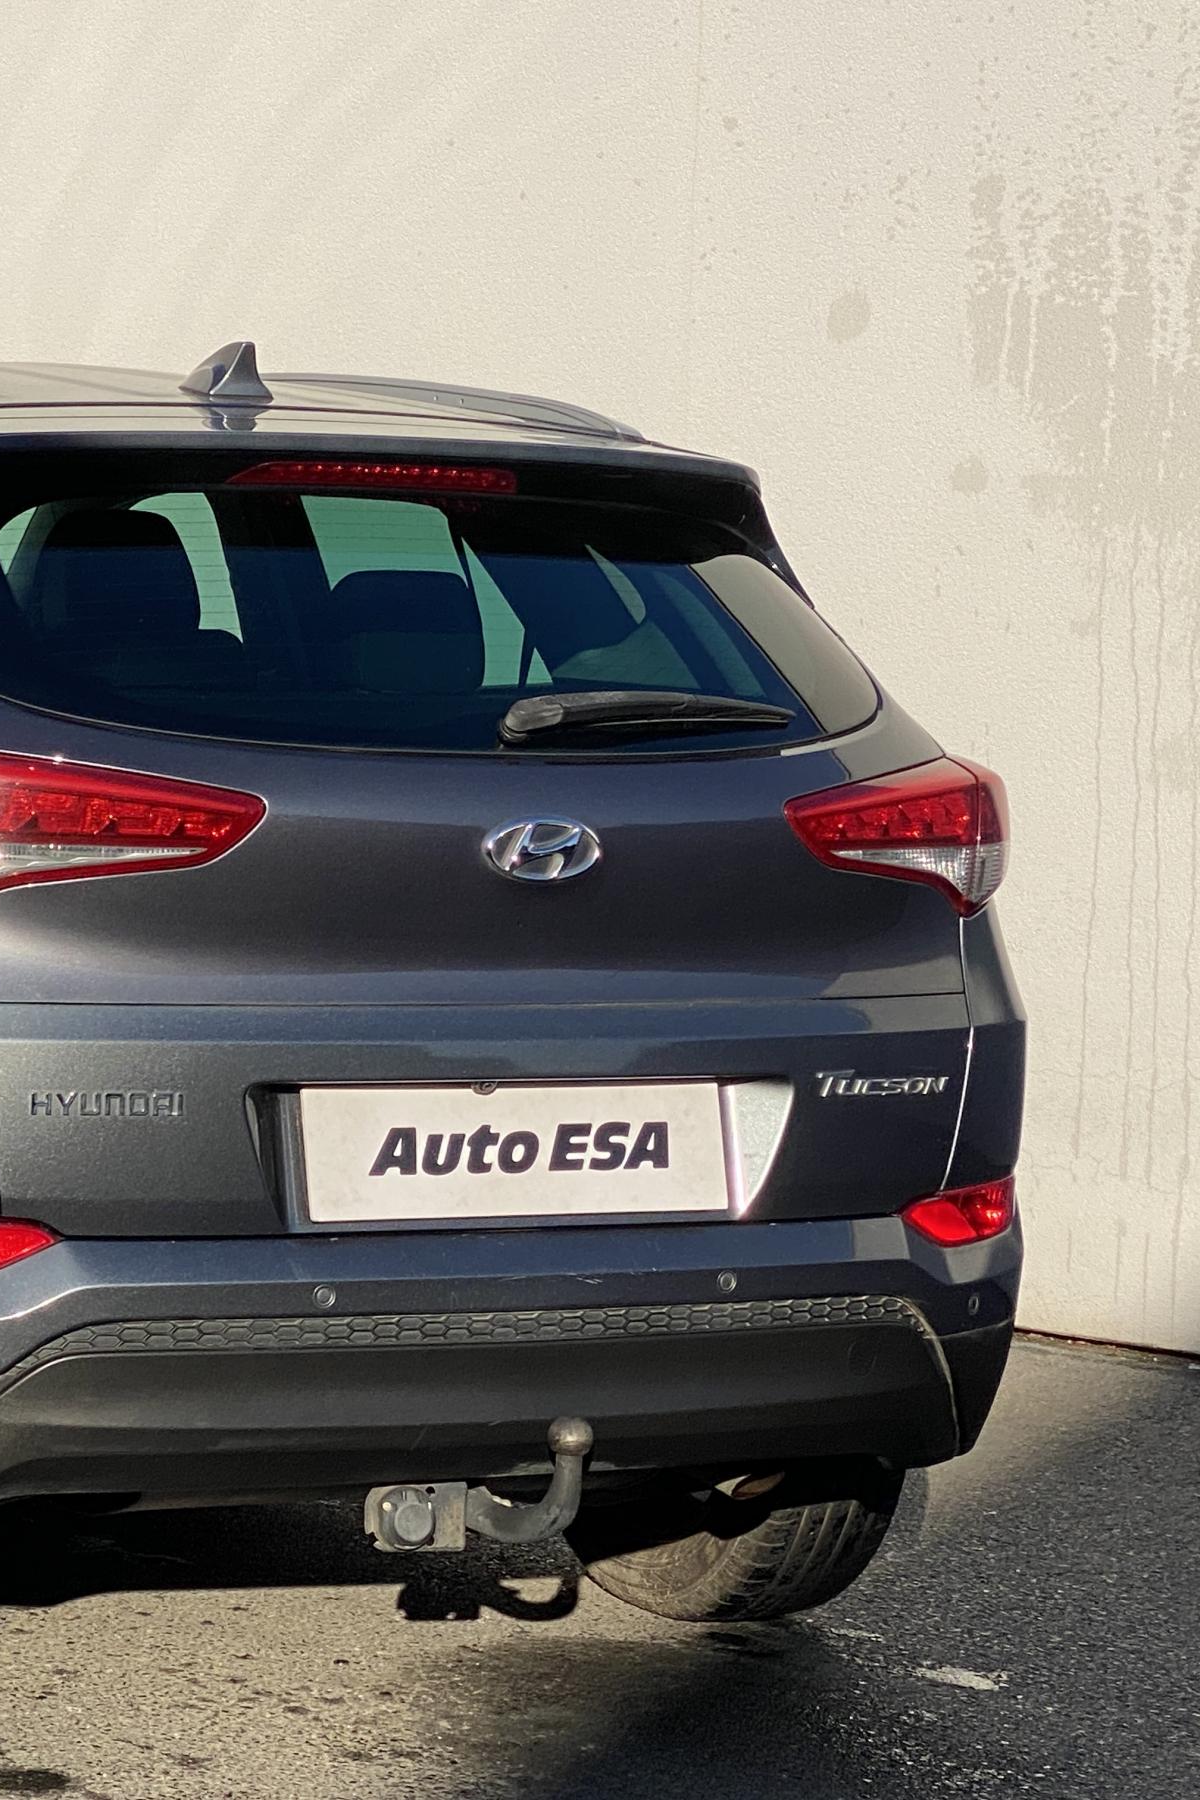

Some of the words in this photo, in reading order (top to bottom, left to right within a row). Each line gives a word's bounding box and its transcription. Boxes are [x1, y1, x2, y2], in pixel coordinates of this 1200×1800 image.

[815, 1068, 950, 1098] TUCSON
[30, 1091, 184, 1117] HYUNDAI
[368, 1124, 540, 1177] Auto
[548, 1121, 670, 1172] ESA
